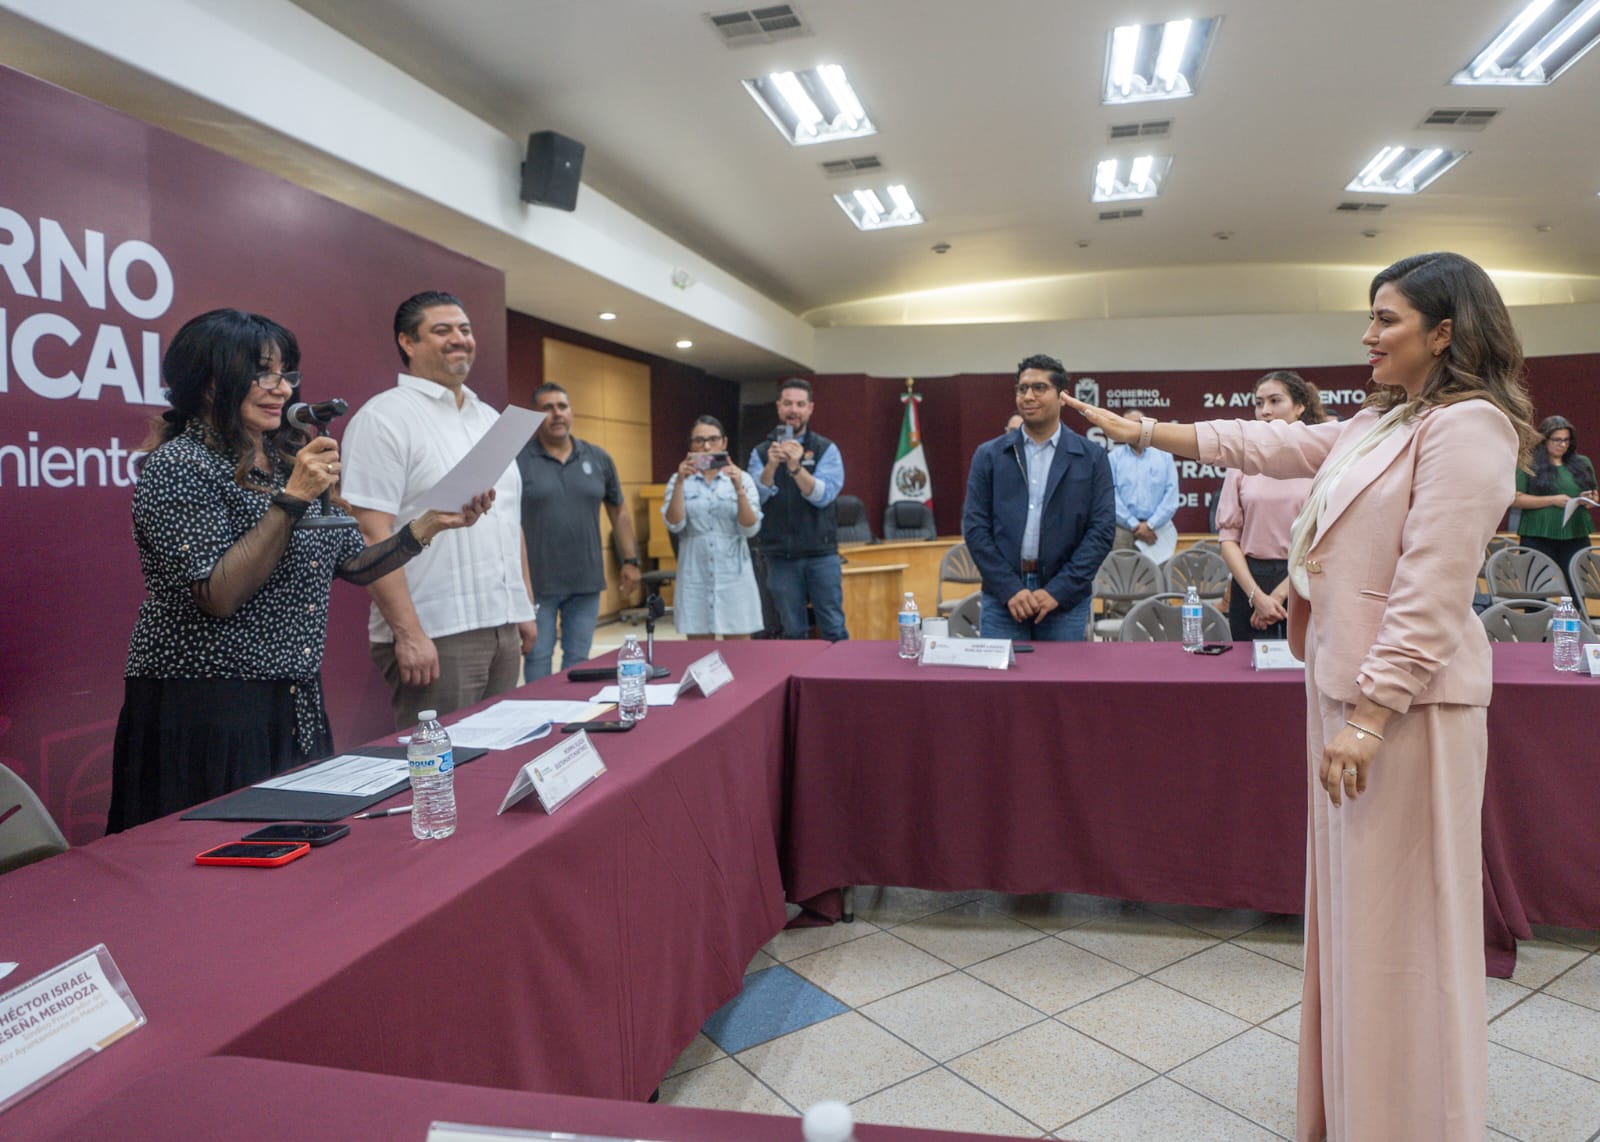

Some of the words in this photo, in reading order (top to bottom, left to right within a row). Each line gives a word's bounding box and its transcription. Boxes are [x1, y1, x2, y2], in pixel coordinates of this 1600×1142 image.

[1106, 389, 1160, 399] GOBIERNO
[1203, 393, 1226, 408] 24
[1107, 399, 1119, 408] DE
[1122, 398, 1170, 408] MEXICALI
[0, 991, 51, 1027] HÉCTOR
[51, 970, 92, 999] ISRAEL
[39, 982, 99, 1021] MENDOZA
